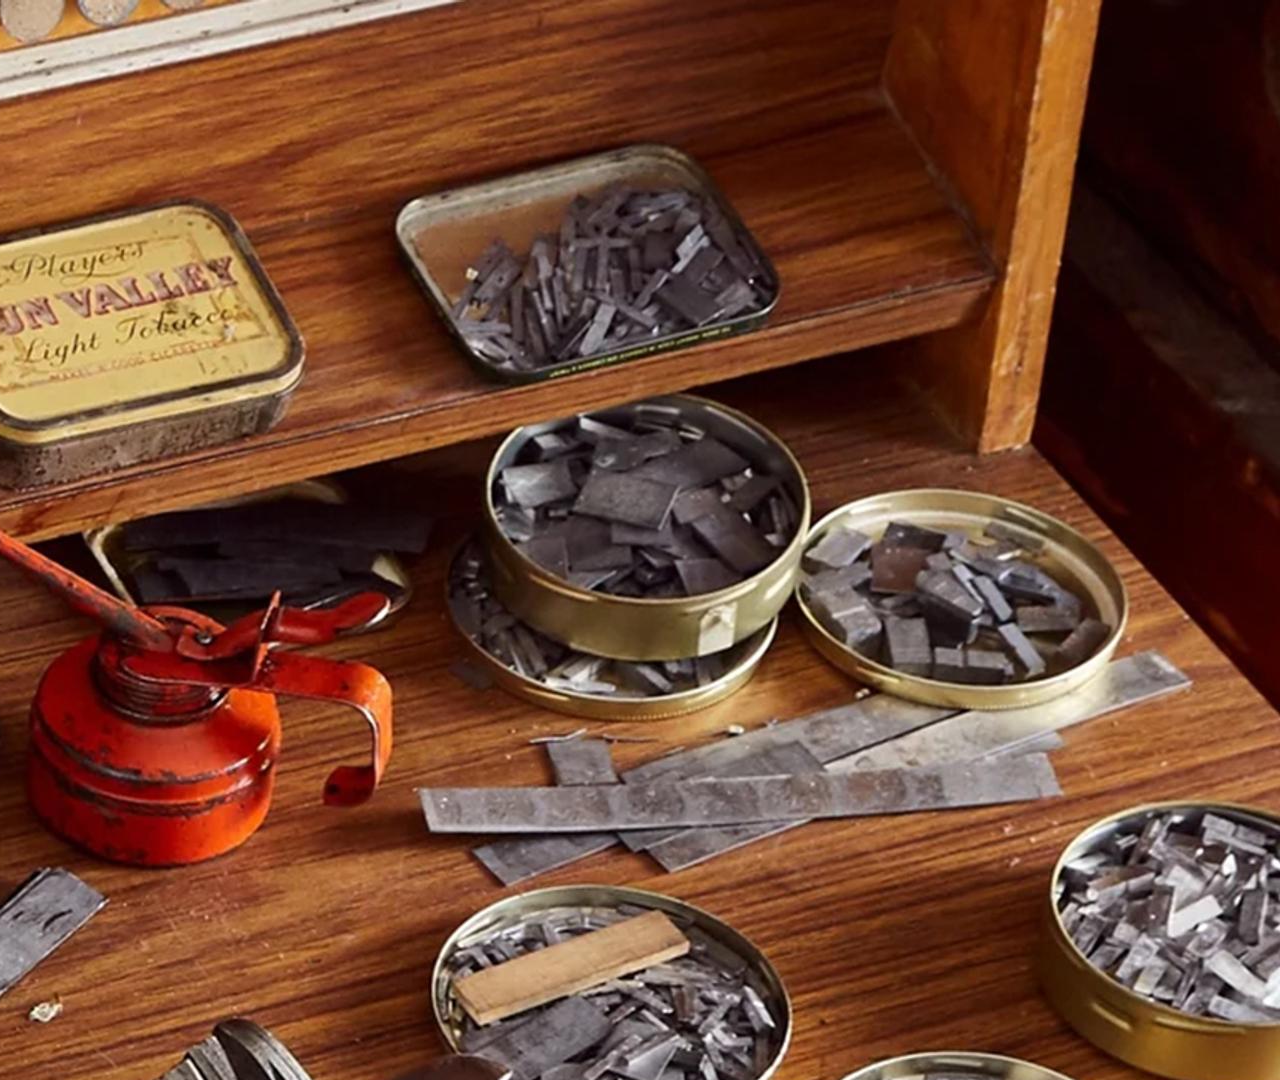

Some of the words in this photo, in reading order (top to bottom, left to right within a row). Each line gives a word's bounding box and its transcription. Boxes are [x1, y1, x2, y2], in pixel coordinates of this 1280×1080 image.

[56, 256, 239, 319] VALLEY
[16, 332, 100, 367] Light
[115, 308, 236, 345] Tobacco
